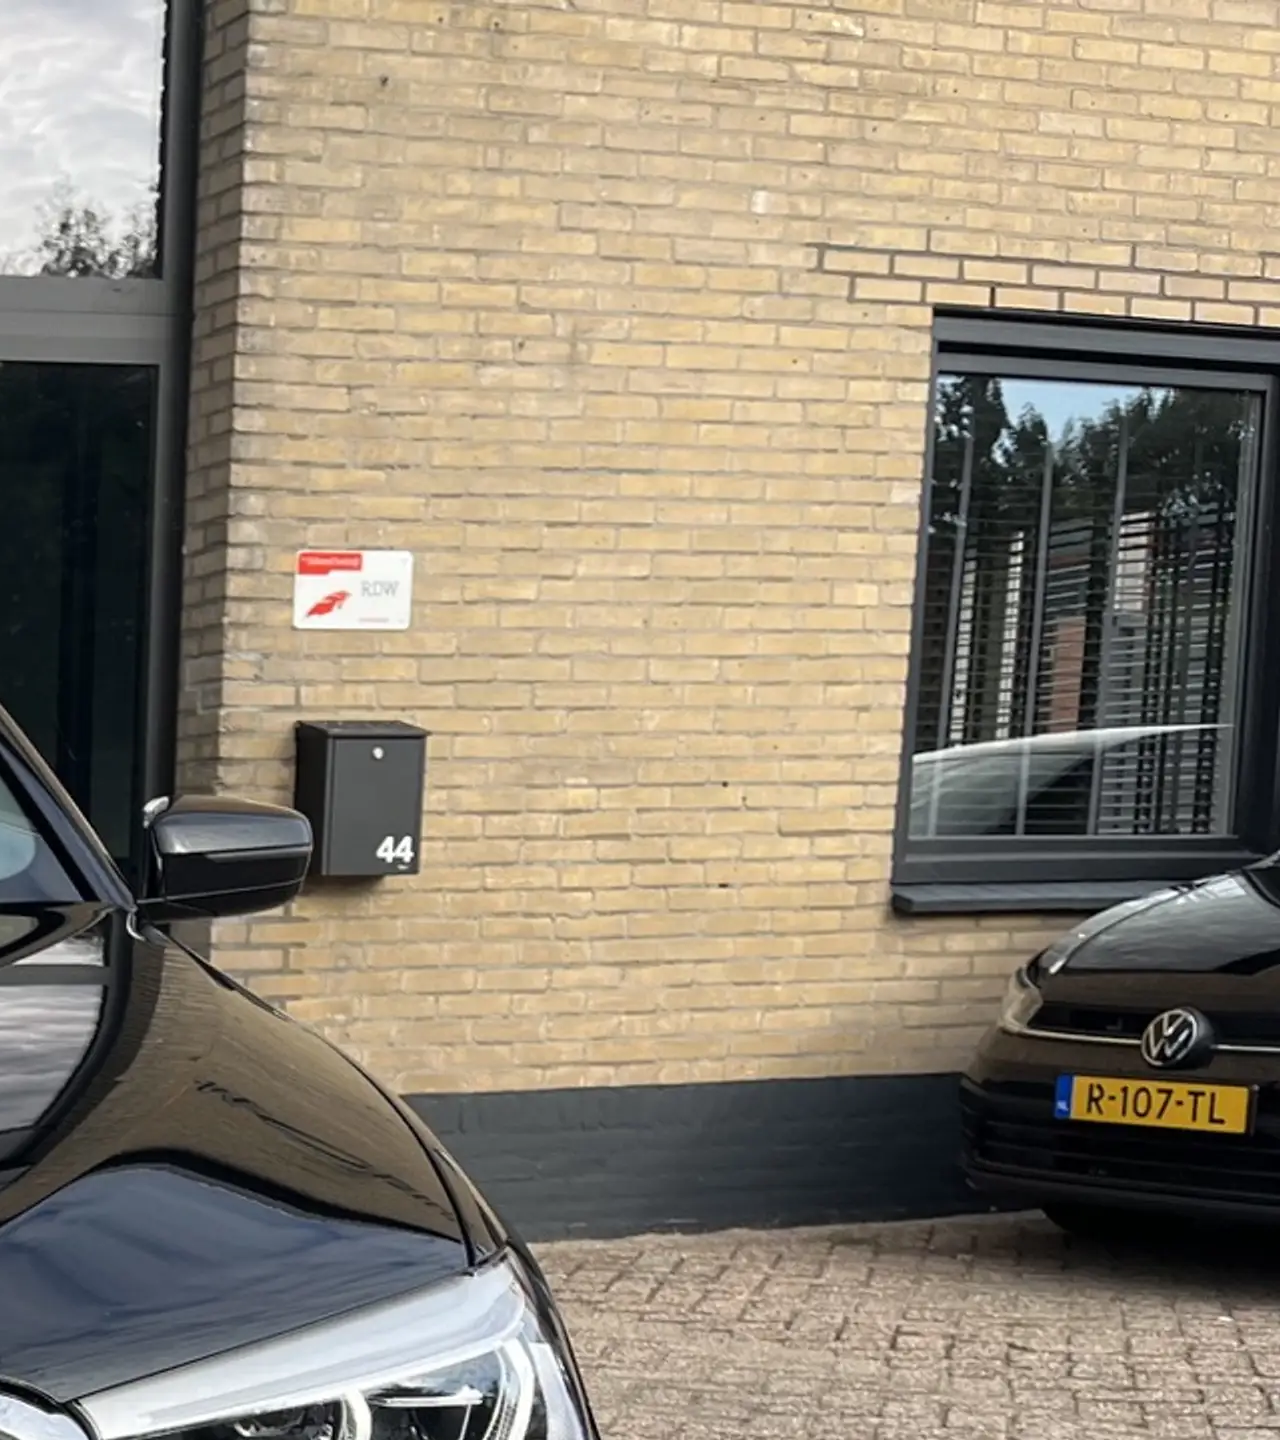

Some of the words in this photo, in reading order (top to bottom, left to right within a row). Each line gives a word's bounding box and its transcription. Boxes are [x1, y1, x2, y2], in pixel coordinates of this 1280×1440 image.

[360, 580, 400, 598] RDW
[375, 835, 415, 863] 44
[1086, 1083, 1226, 1125] R-107-TL
